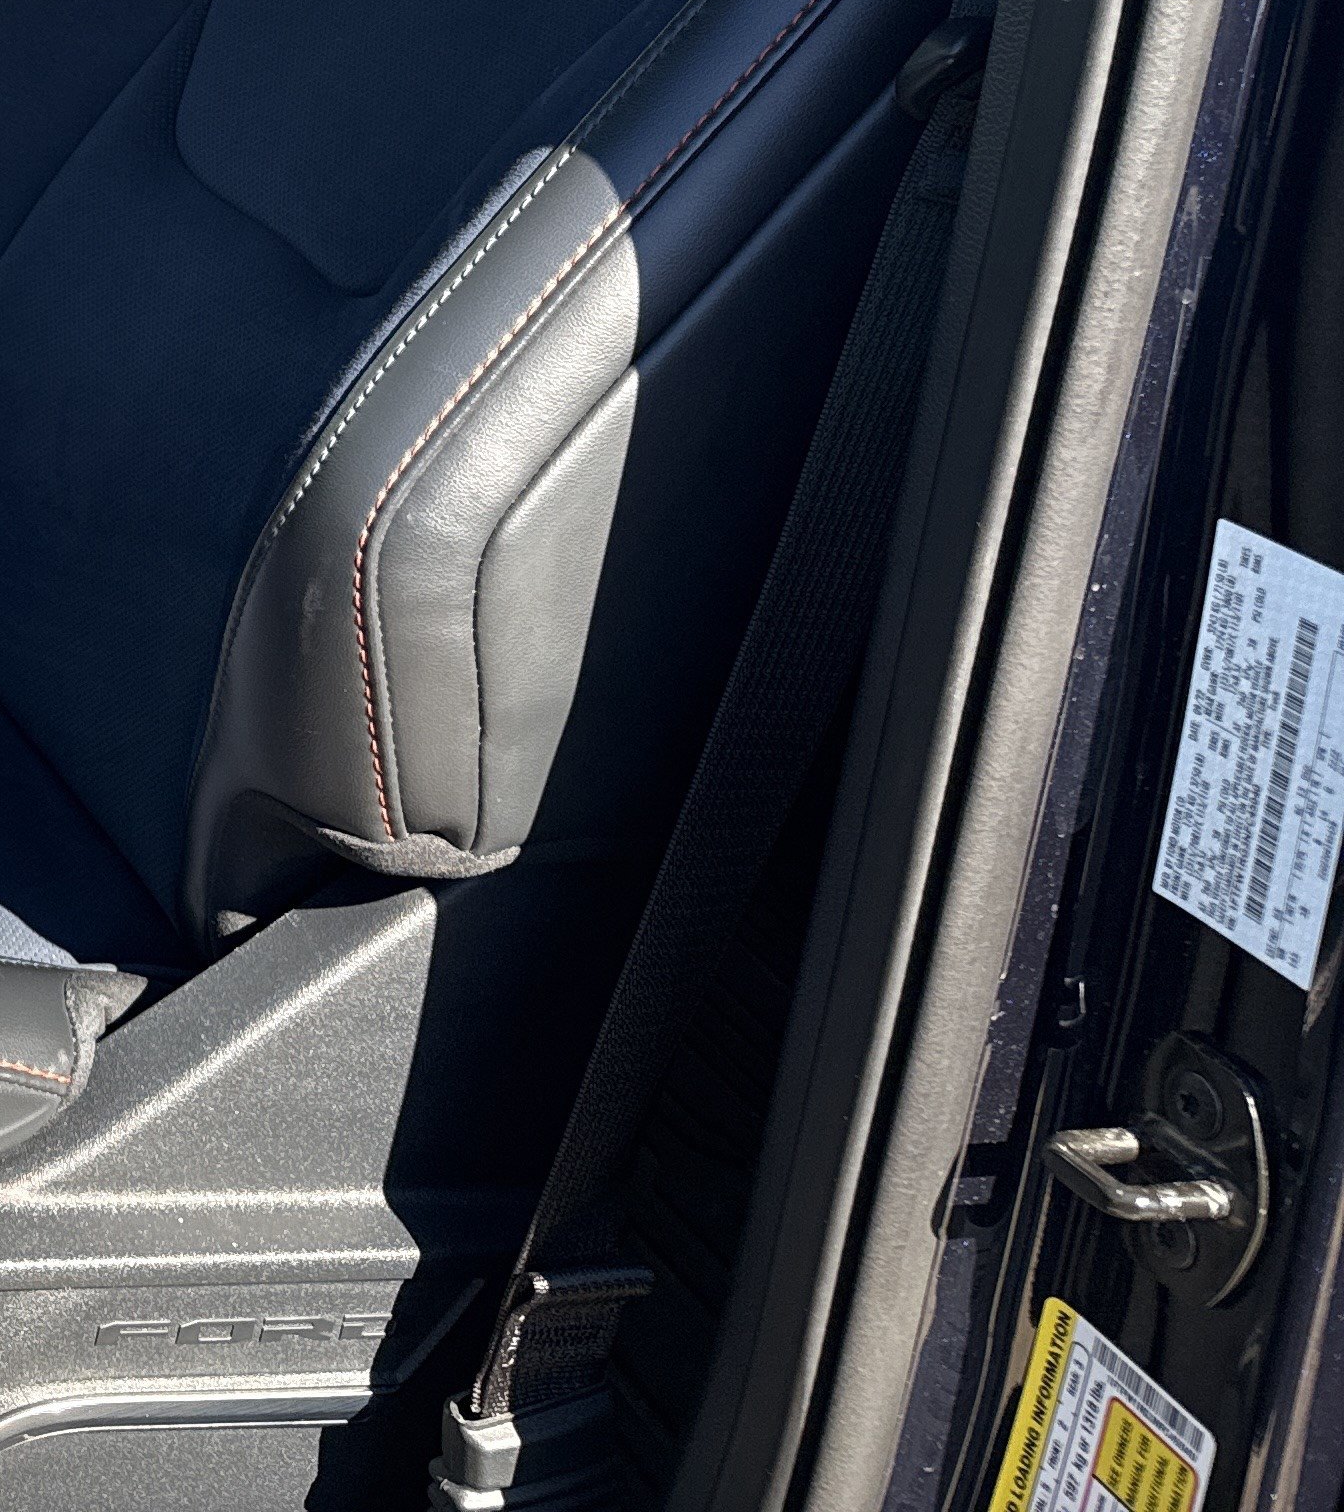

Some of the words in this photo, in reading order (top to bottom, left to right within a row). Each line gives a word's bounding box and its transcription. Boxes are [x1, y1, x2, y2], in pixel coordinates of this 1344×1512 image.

[1171, 808, 1183, 836] MOTOR
[1167, 836, 1178, 857] FORD
[1010, 1427, 1040, 1501] LOADING
[1031, 1310, 1071, 1426] INFORMATION
[1058, 1420, 1068, 1431] 2
[1072, 1453, 1088, 1472] kg
[1080, 1437, 1089, 1453] or
[1108, 1467, 1120, 1488] SEE
[1125, 1461, 1145, 1507] MANUAL
[1137, 1434, 1150, 1459] FOR
